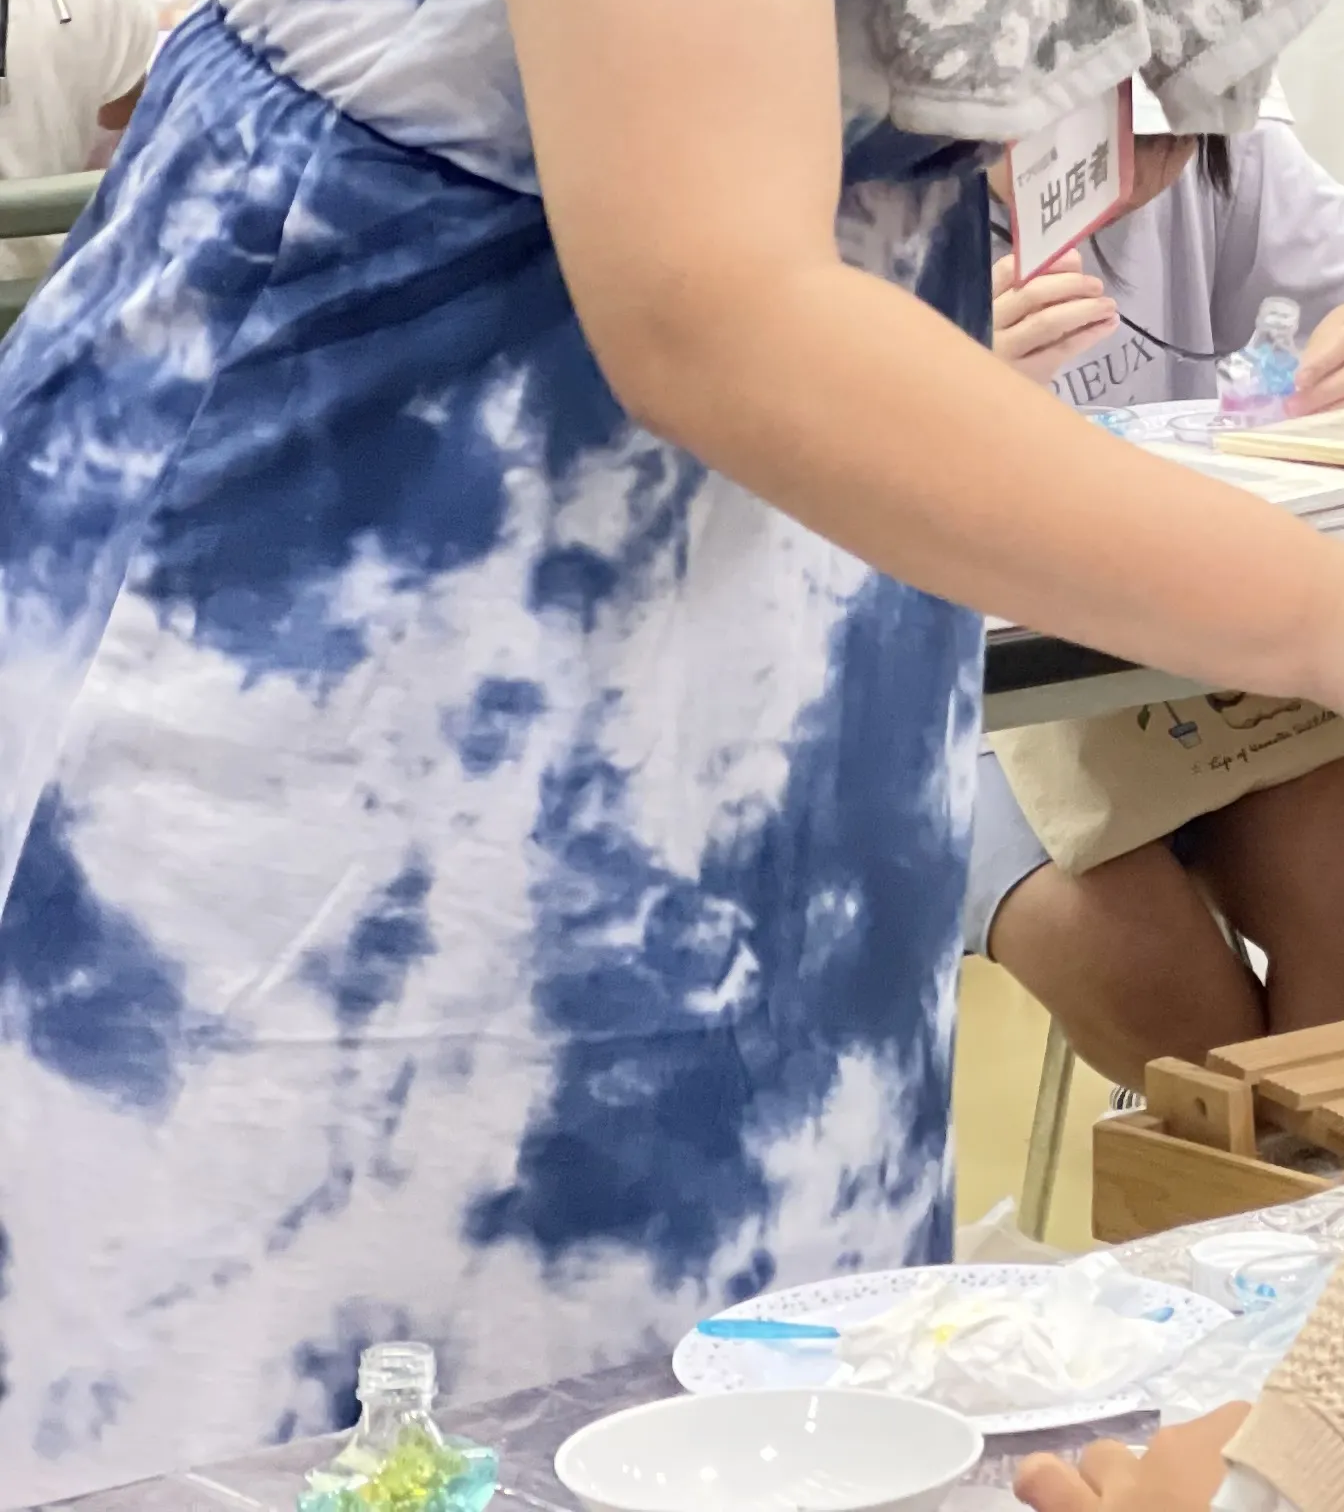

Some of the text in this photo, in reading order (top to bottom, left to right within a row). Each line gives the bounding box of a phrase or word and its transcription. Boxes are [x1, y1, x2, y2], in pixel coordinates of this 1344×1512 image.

[1039, 138, 1110, 236] 出店者
[1050, 327, 1155, 406] IEUX
